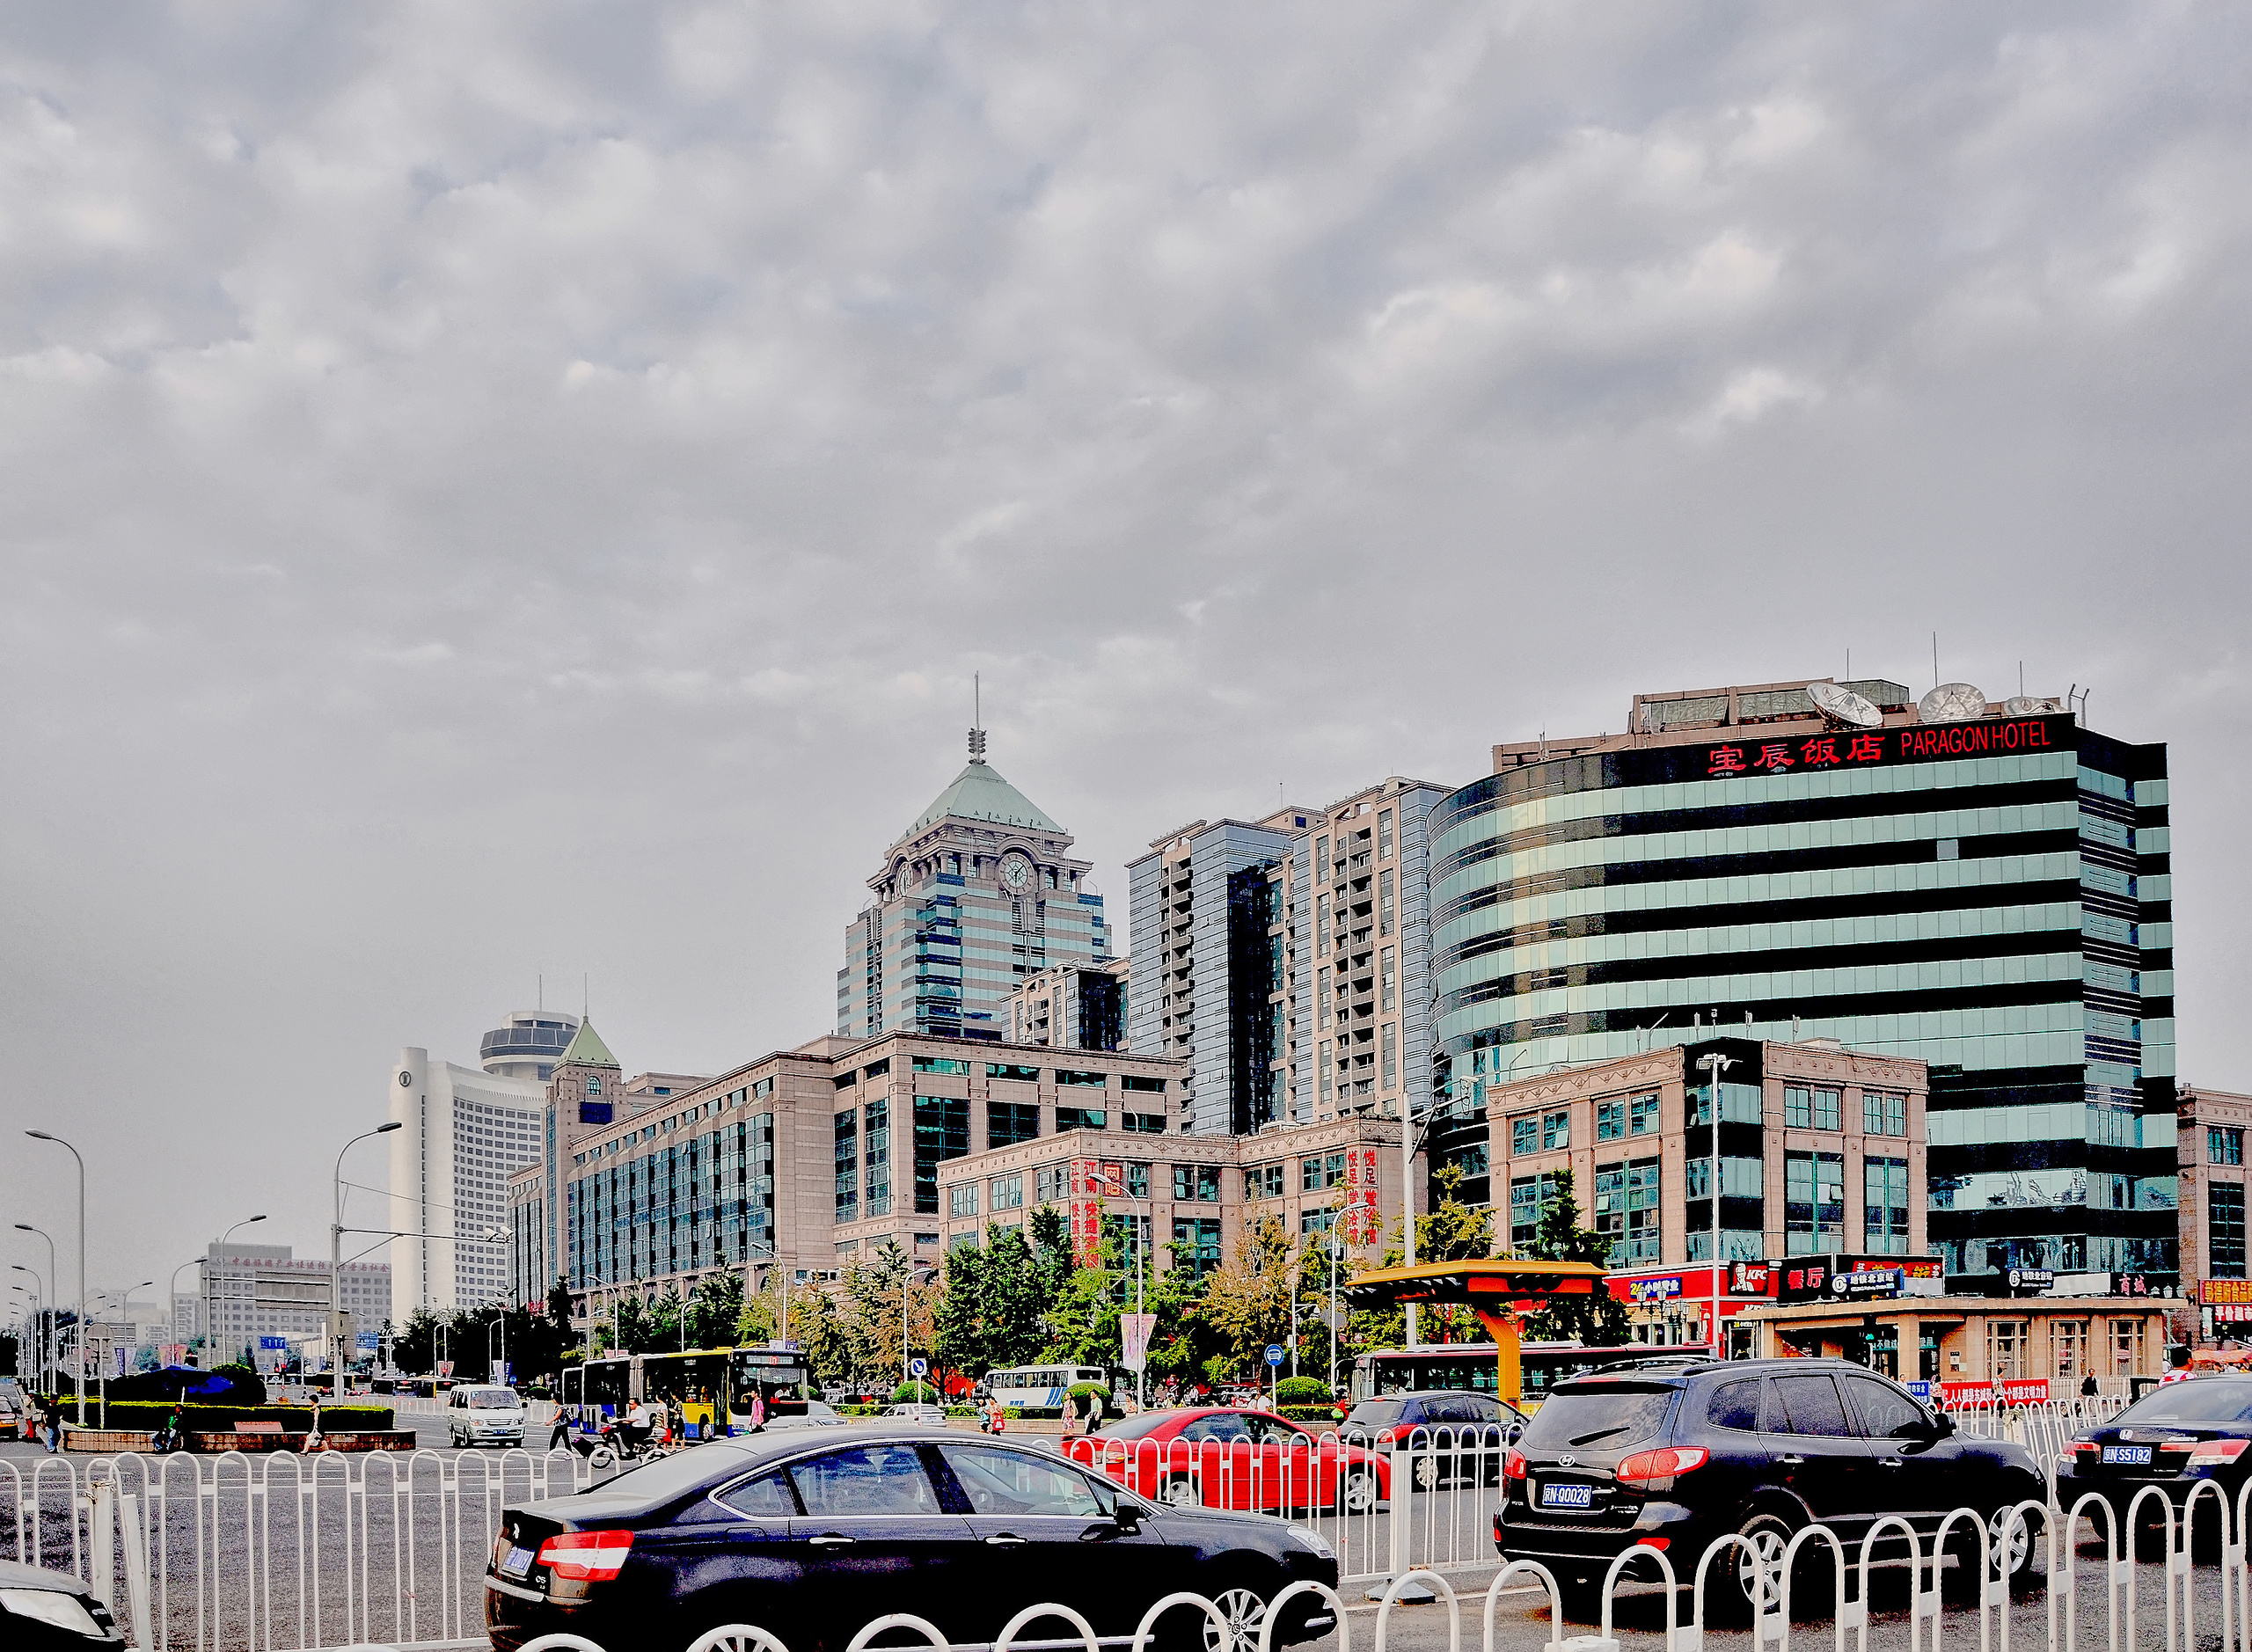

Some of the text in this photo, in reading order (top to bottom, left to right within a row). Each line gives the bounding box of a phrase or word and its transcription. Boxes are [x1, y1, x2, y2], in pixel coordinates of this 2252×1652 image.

[1901, 721, 2051, 757] PARAGON HOTEL
[1707, 734, 1885, 774] 宝辰饭店
[1746, 1269, 1768, 1280] KFC
[1788, 1267, 1824, 1290] 餐厅
